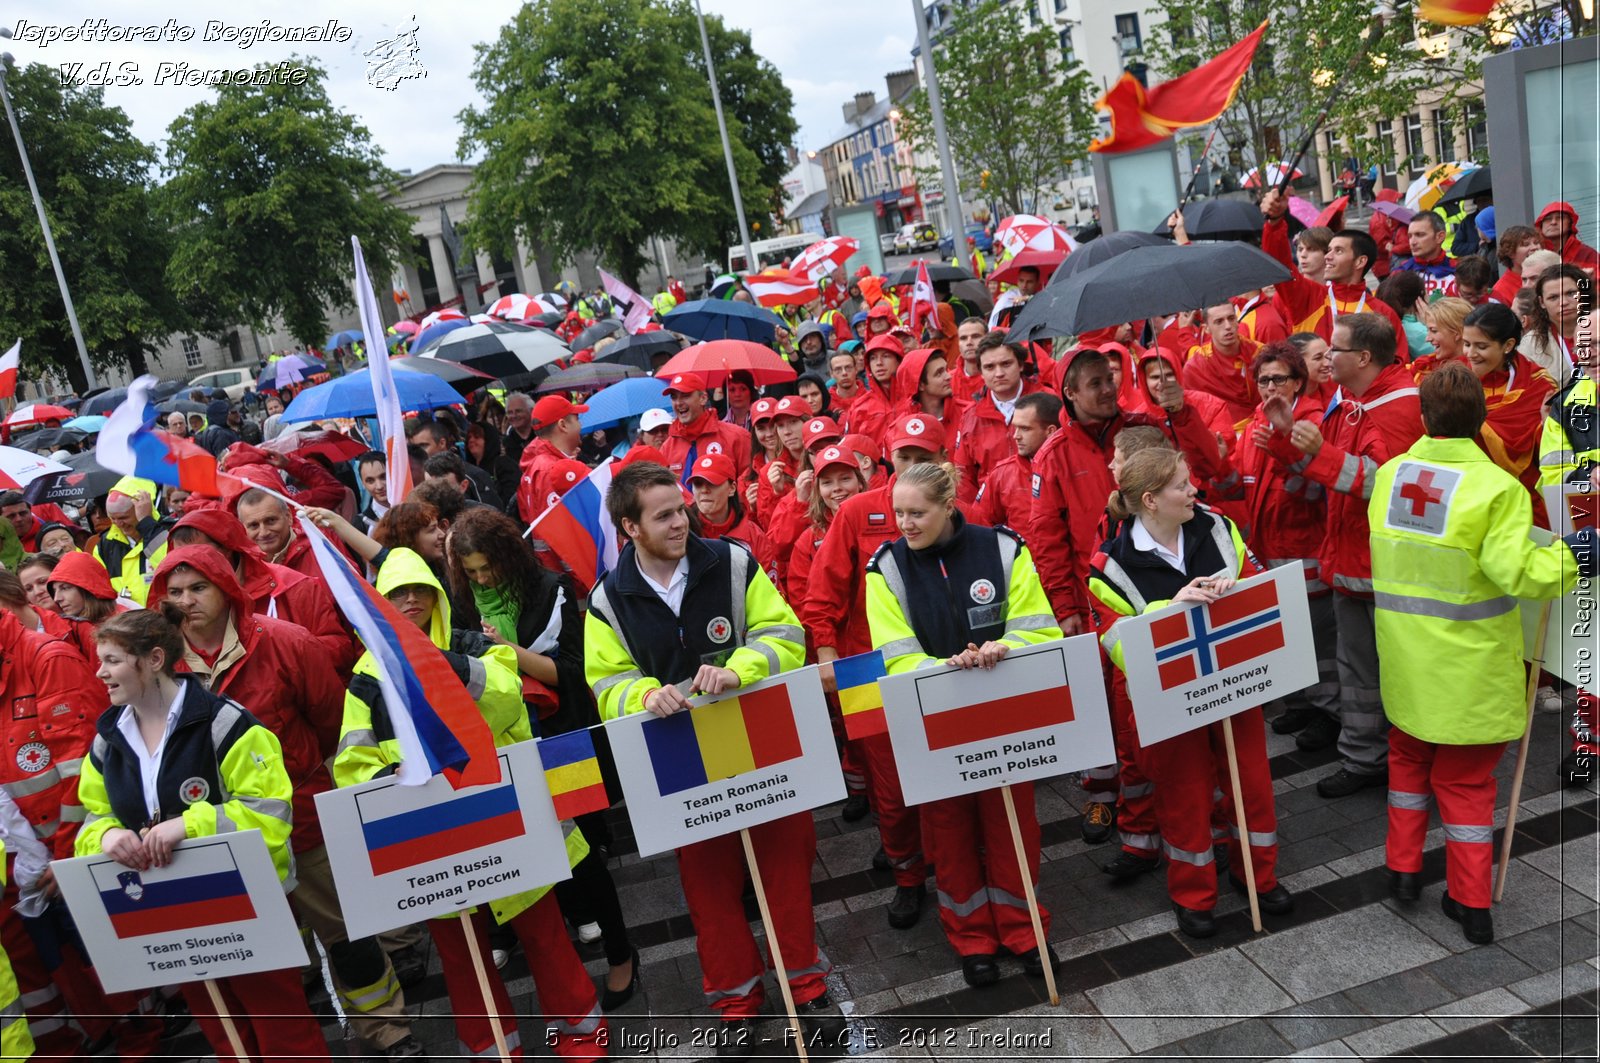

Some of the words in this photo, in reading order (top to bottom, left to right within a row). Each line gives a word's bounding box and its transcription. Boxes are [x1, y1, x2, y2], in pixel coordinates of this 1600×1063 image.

[46, 487, 85, 499] LONDON
[1184, 683, 1219, 701] Team
[1222, 664, 1269, 688] Norway
[1185, 693, 1233, 716] Teamet
[1236, 679, 1273, 699] Norge
[955, 749, 998, 765] Team
[1002, 734, 1056, 755] Poland
[959, 766, 1002, 781] Team
[1007, 754, 1058, 772] Polska
[683, 793, 723, 811] Team
[727, 774, 789, 798] Romania
[684, 808, 731, 829] Echipa
[735, 789, 797, 814] România
[397, 885, 463, 910] Сборная
[467, 868, 521, 891] России
[407, 870, 449, 889] Team
[453, 855, 503, 876] Russia
[143, 942, 182, 955] Team
[185, 932, 245, 949] Slovenia
[147, 958, 187, 971] Team
[189, 948, 254, 966] Slovenija
